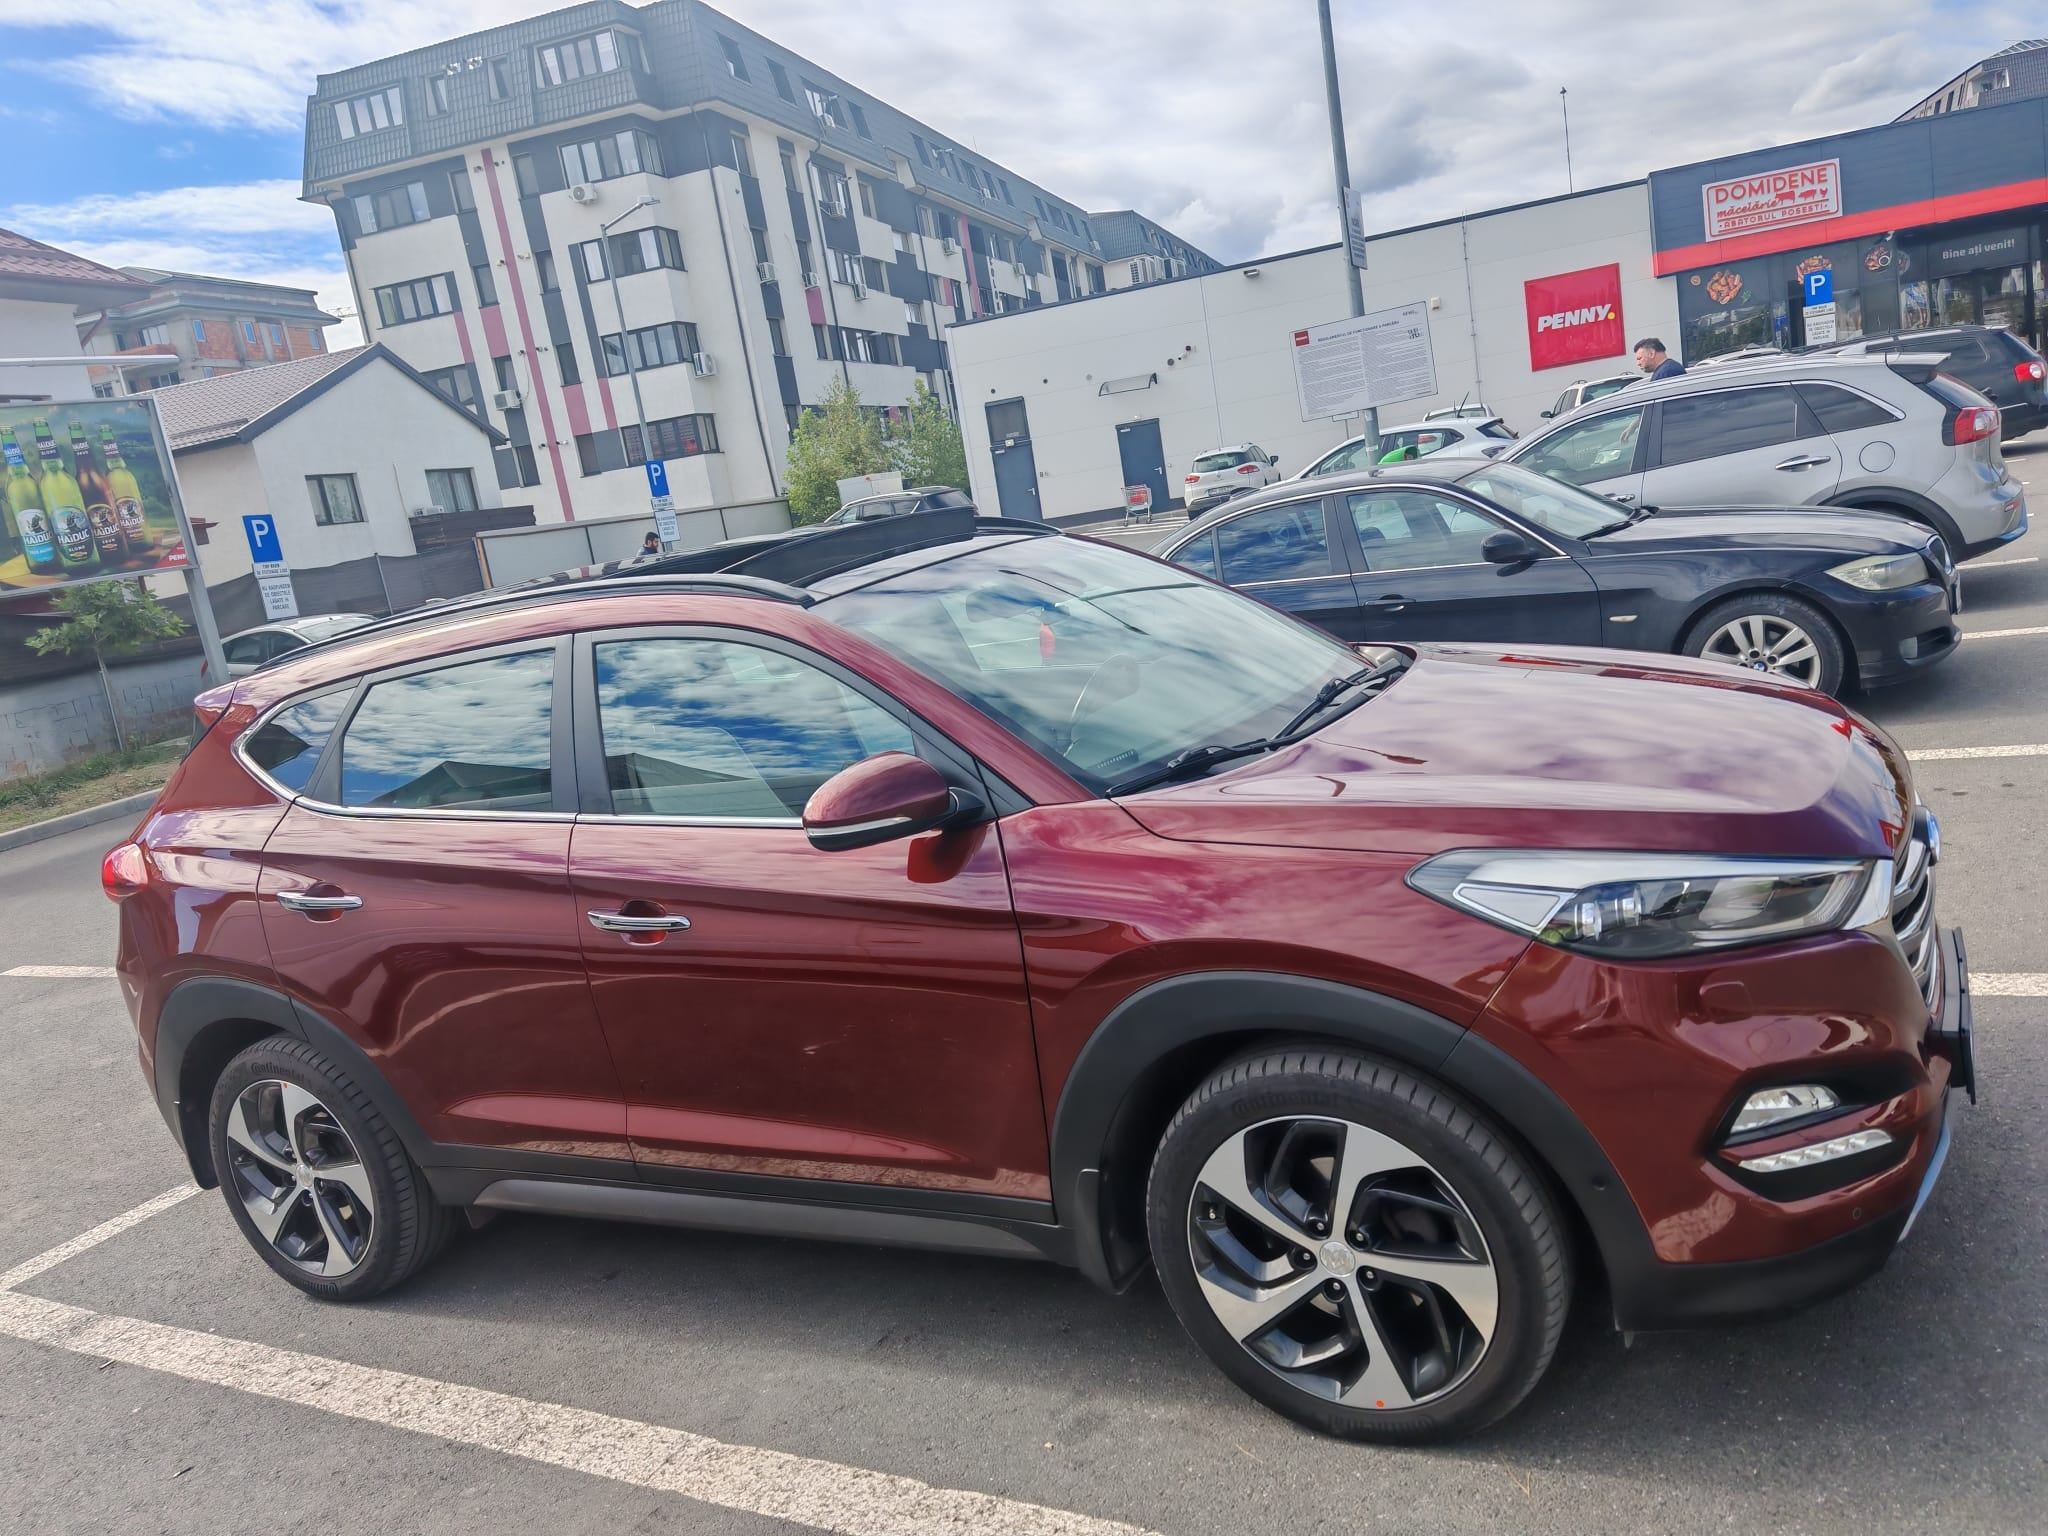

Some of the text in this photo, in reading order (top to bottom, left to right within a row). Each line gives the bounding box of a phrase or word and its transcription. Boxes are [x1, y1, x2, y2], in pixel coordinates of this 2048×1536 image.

[1715, 167, 1828, 204] DOMIDENE
[1724, 213, 1777, 228] ABATORUL
[1942, 249, 1966, 260] Bine
[1984, 238, 2016, 252] venit!
[1810, 274, 1826, 296] P
[650, 463, 661, 486] P
[57, 529, 90, 544] HAIDUC
[251, 519, 269, 548] P
